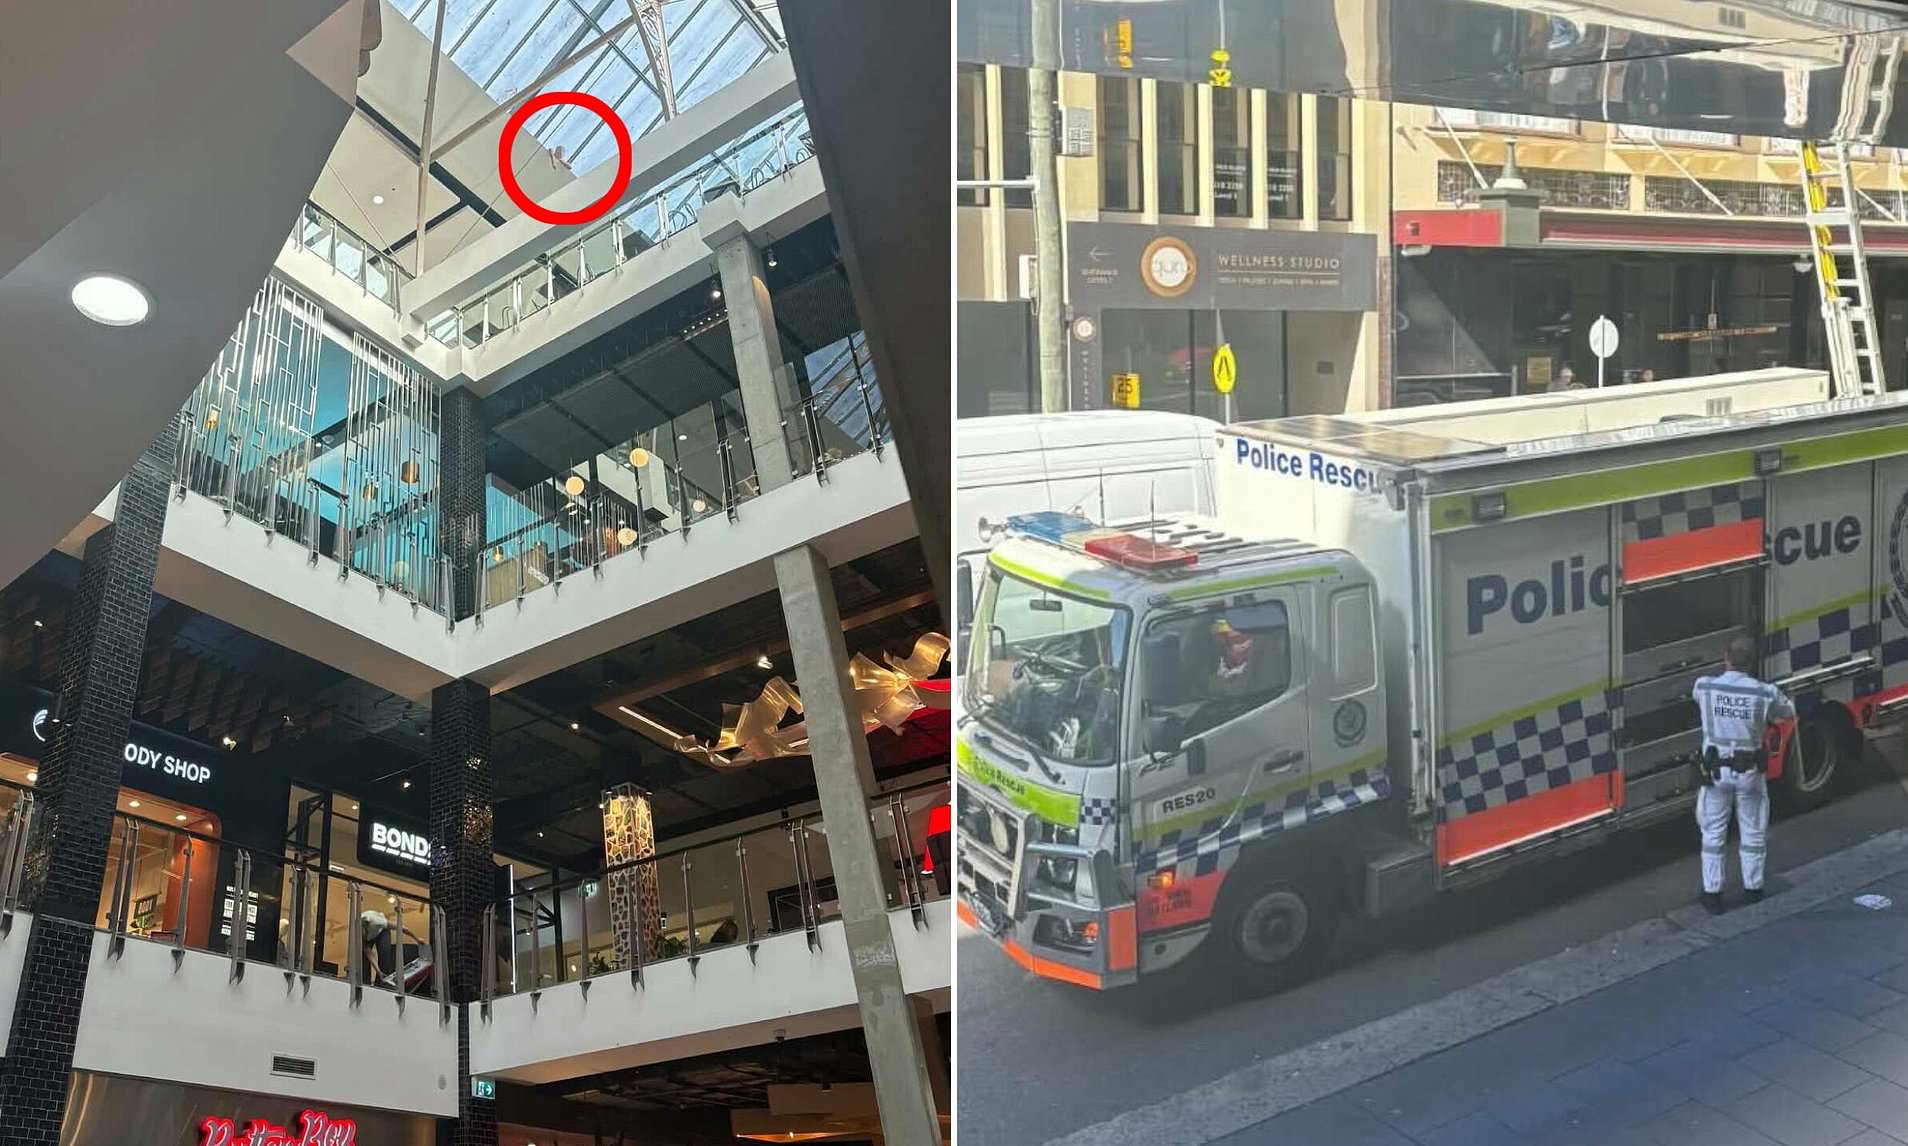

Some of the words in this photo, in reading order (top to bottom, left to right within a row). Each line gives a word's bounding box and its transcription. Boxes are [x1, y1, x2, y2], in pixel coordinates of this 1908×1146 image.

[1218, 255, 1284, 268] WELLNESS
[1291, 256, 1341, 270] STUDIO
[1236, 438, 1303, 477] Police
[1309, 452, 1382, 495] Rescu
[1467, 555, 1617, 636] Polic
[1767, 515, 1862, 566] cue
[1714, 705, 1752, 720] RESCUE
[1716, 695, 1751, 708] POLICE
[124, 743, 162, 769] ODY
[163, 755, 211, 784] SHOP
[1162, 787, 1216, 814] RES20
[372, 821, 432, 859] BOND
